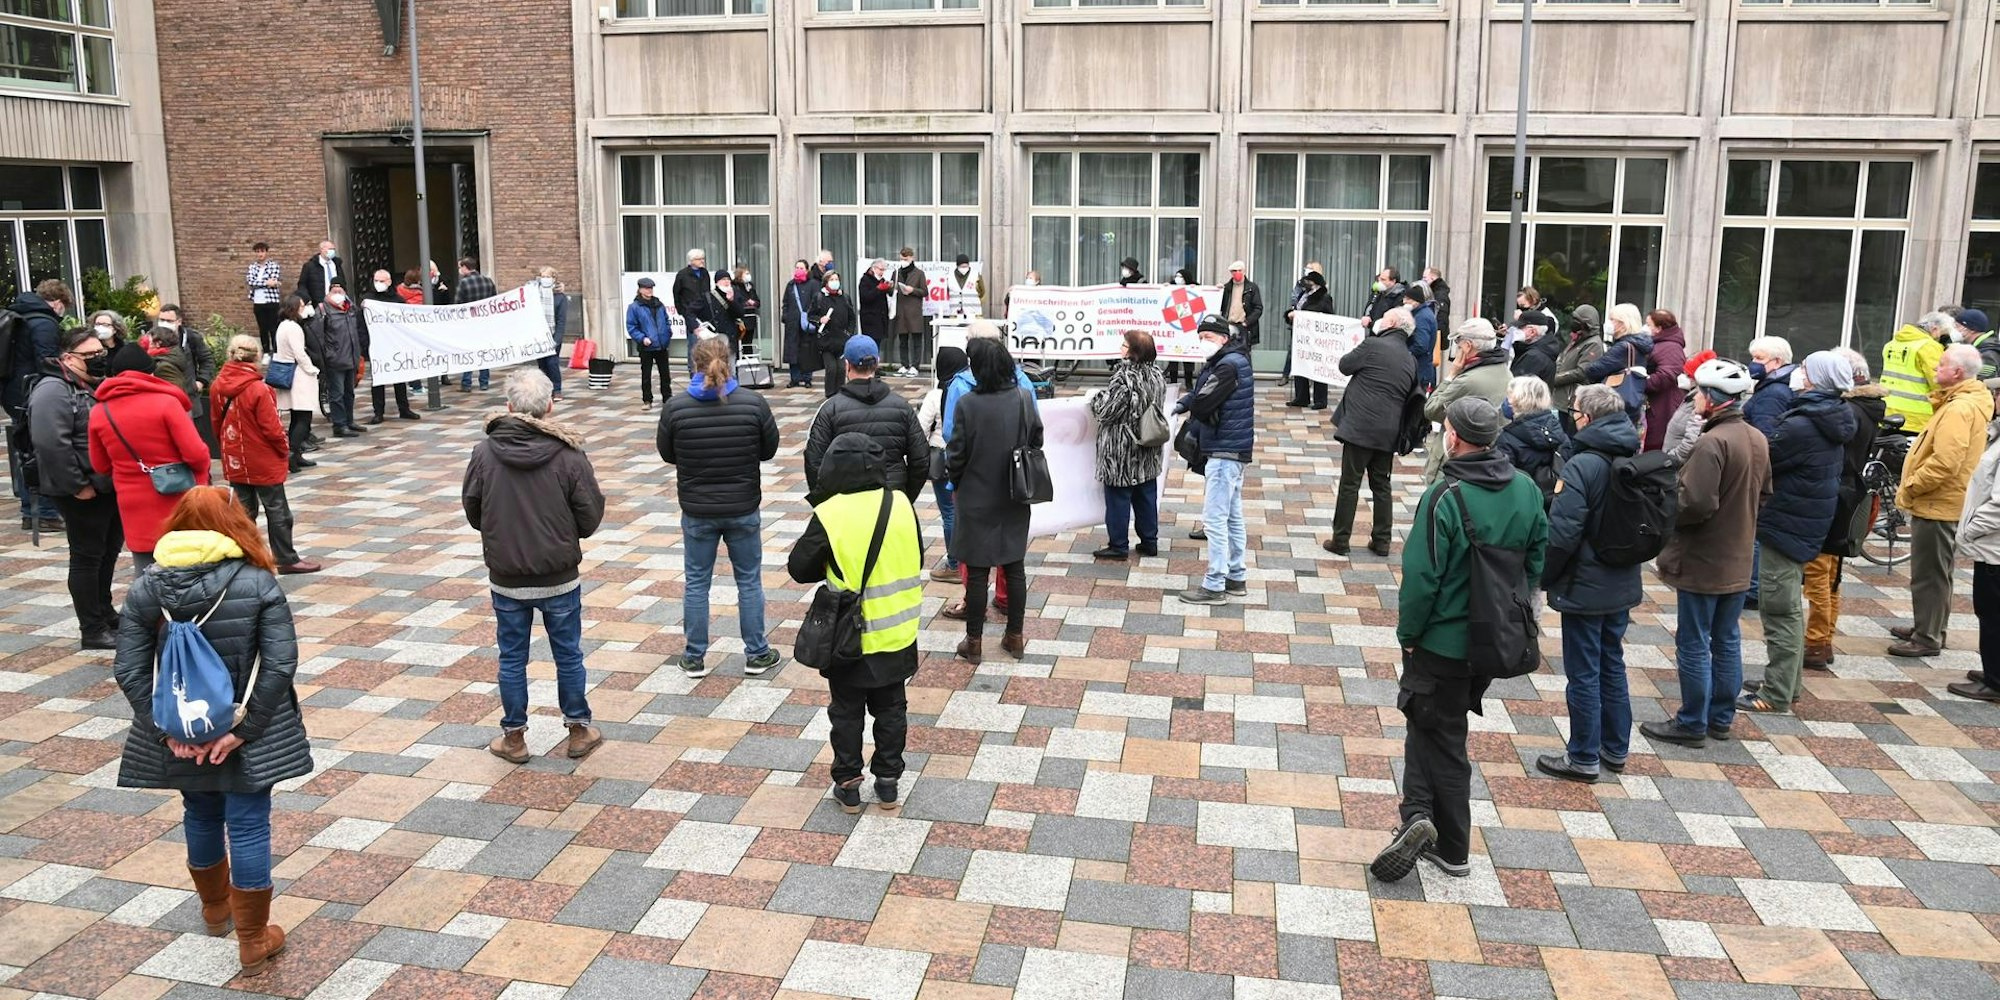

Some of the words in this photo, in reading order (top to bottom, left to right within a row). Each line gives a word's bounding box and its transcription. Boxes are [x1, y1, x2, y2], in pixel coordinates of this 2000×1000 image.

[1013, 298, 1078, 306] Unterschriften
[1099, 297, 1158, 305] Volksinitiative
[1151, 329, 1175, 338] ALLE!
[1296, 335, 1310, 345] WIR
[372, 358, 391, 375] Die
[452, 352, 474, 366] muss
